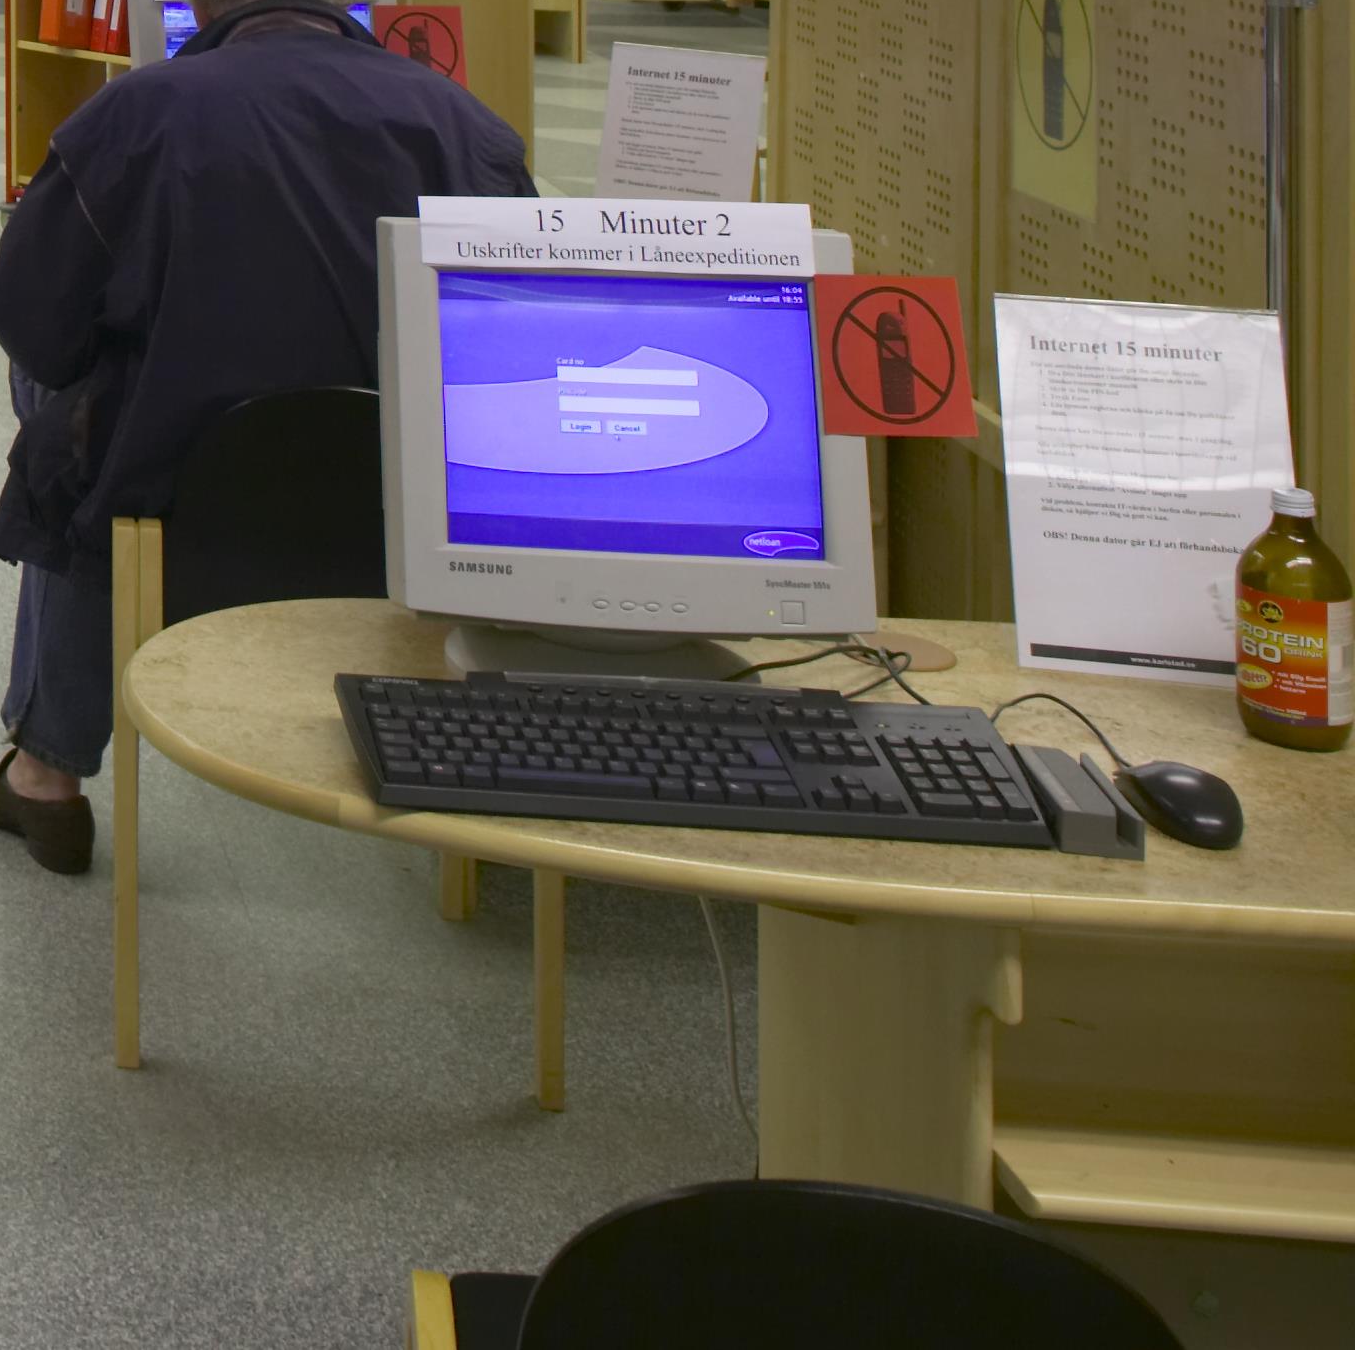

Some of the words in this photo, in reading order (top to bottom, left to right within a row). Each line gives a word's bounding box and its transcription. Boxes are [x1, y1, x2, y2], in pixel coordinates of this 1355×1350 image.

[627, 66, 671, 80] Internet
[674, 71, 686, 81] 15
[688, 73, 732, 86] minuter
[535, 208, 565, 233] 15
[600, 209, 708, 237] Minuter
[716, 213, 732, 237] 2
[457, 241, 544, 260] Utskrifter
[548, 244, 622, 262] kommer
[628, 245, 634, 262] i
[640, 245, 801, 268] Låneexpeditionen
[1030, 335, 1108, 355] Internet
[1116, 340, 1137, 357] 15
[1143, 344, 1224, 363] minuter
[570, 422, 593, 433] Login
[613, 424, 641, 433] Cancel
[1070, 532, 1100, 543] Denna
[1102, 535, 1127, 545] dator
[448, 560, 513, 576] SAMSUNG
[765, 578, 811, 590] SyncMaster
[1241, 635, 1282, 664] 60
